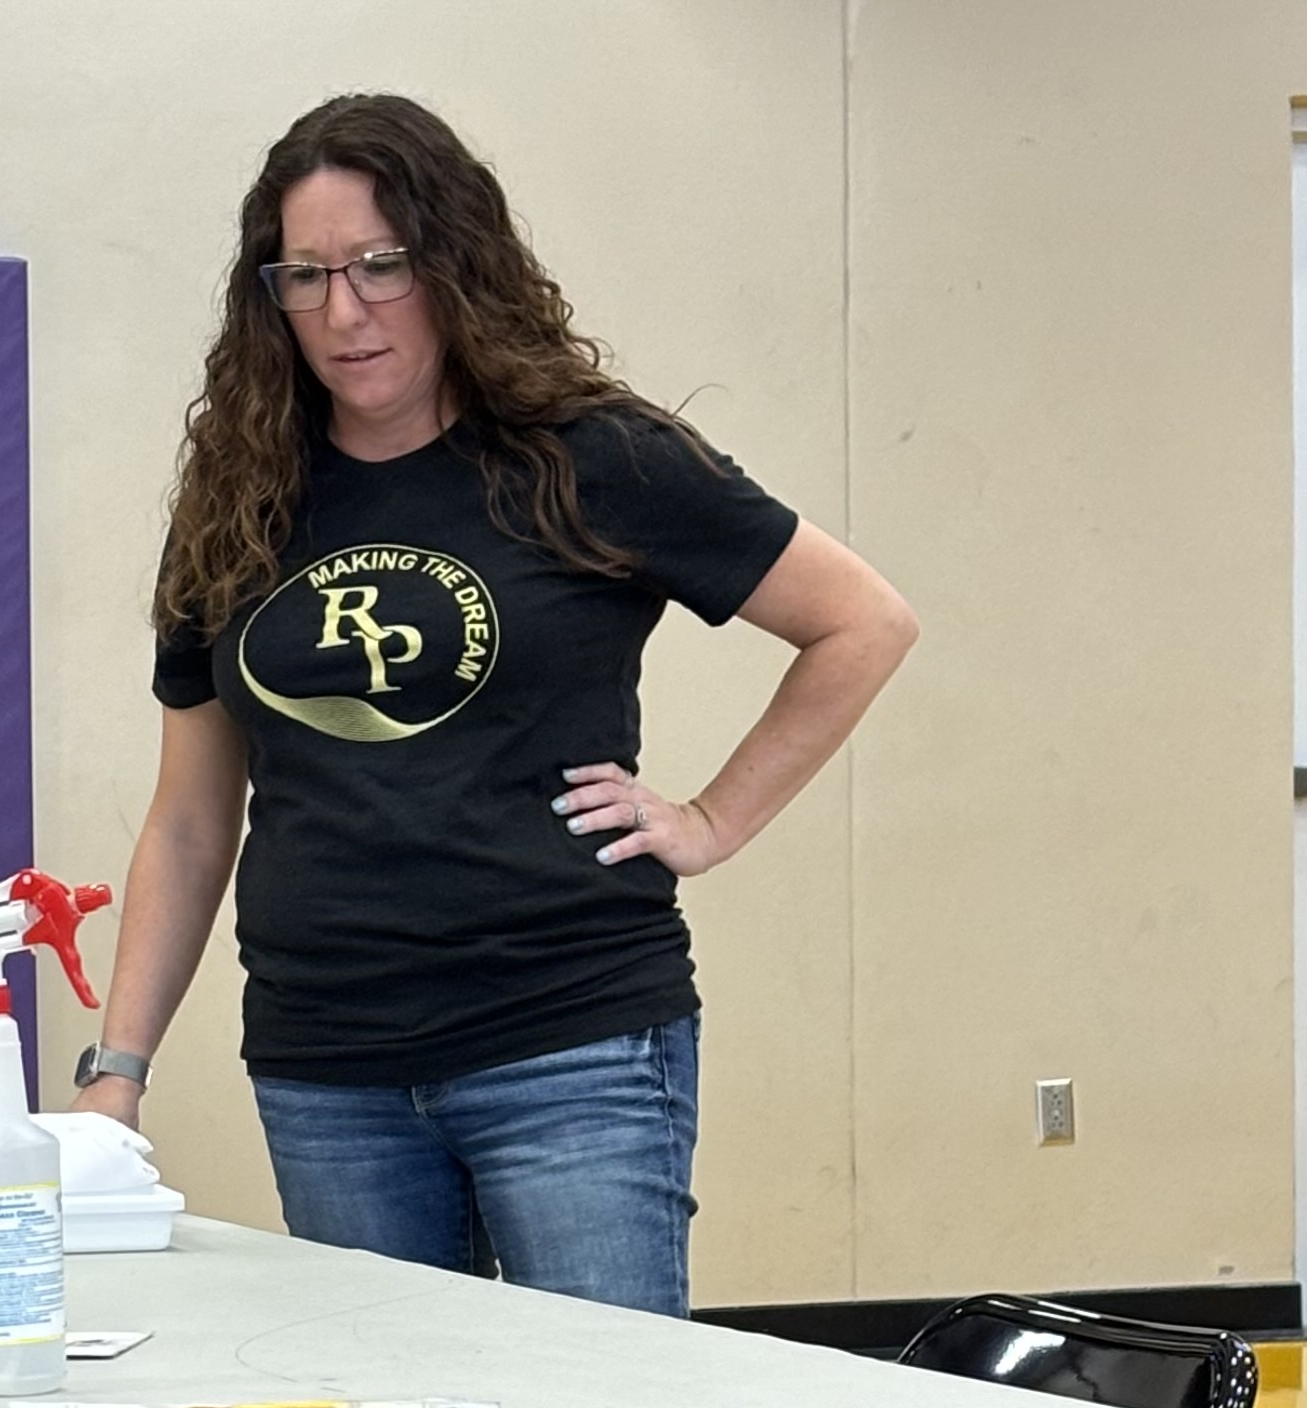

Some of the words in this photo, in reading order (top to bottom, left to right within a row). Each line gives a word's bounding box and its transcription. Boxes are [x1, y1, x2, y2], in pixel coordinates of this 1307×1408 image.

[307, 550, 418, 589] MAKING
[420, 557, 467, 590] THE
[454, 585, 490, 683] DREAM
